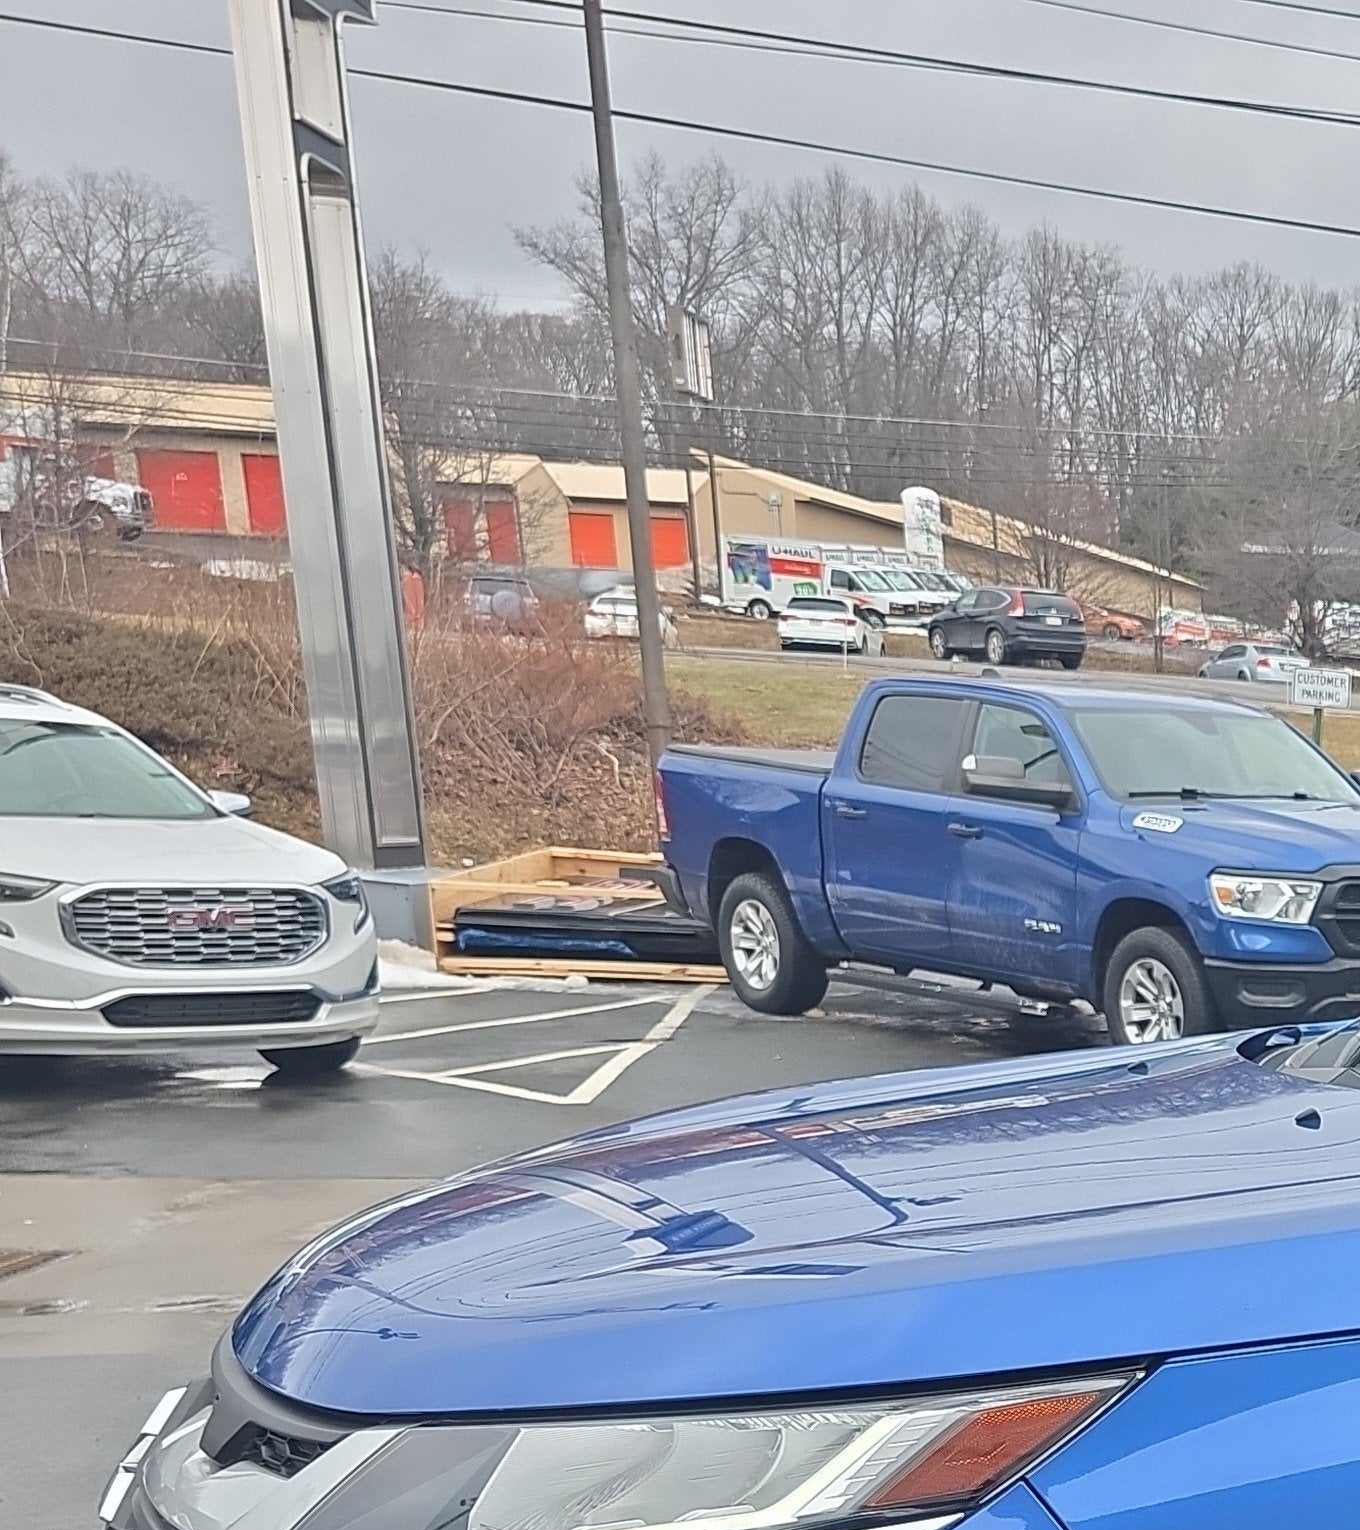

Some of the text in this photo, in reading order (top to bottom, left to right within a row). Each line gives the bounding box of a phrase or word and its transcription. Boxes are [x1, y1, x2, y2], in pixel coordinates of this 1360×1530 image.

[771, 546, 815, 559] U-HAUL
[1297, 674, 1346, 689] CUSTOMER
[1302, 690, 1340, 703] PARKING
[167, 907, 256, 931] GMC
